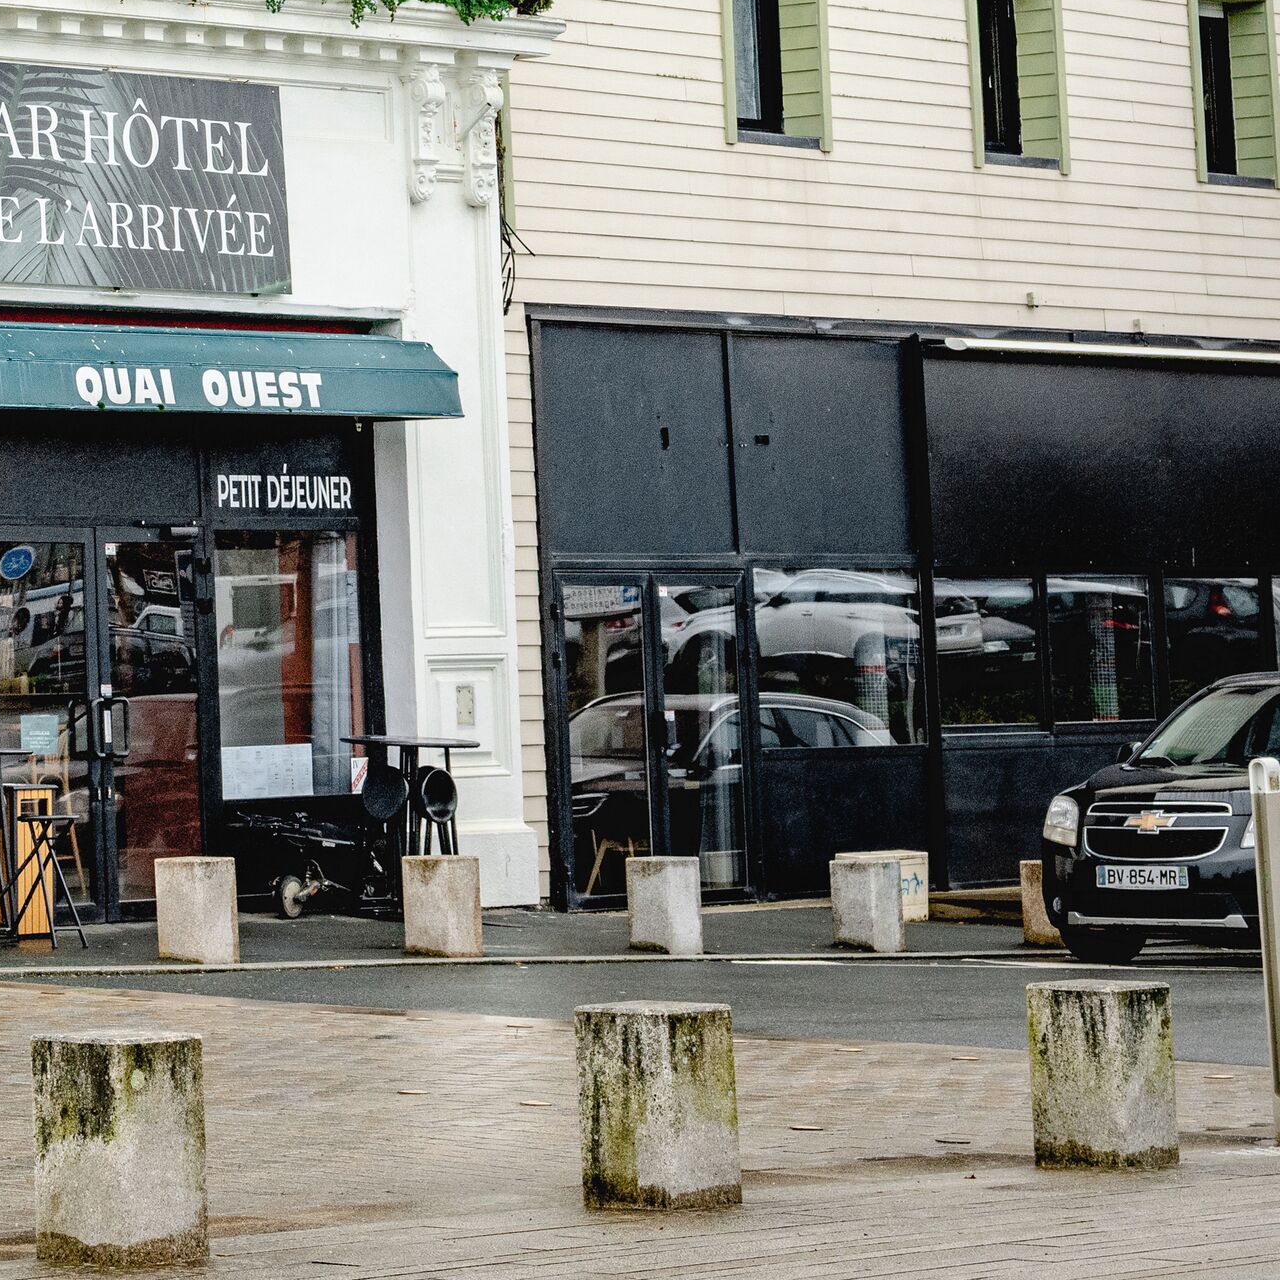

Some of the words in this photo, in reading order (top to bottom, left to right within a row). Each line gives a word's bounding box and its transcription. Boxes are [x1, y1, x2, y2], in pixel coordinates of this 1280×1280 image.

[80, 97, 269, 177] HÔTEL
[75, 366, 177, 407] QUAI
[202, 369, 323, 408] OUEST
[217, 474, 261, 508] PETIT
[267, 463, 352, 509] DÉJEUNER
[1107, 869, 1177, 886] BV-854-MR
